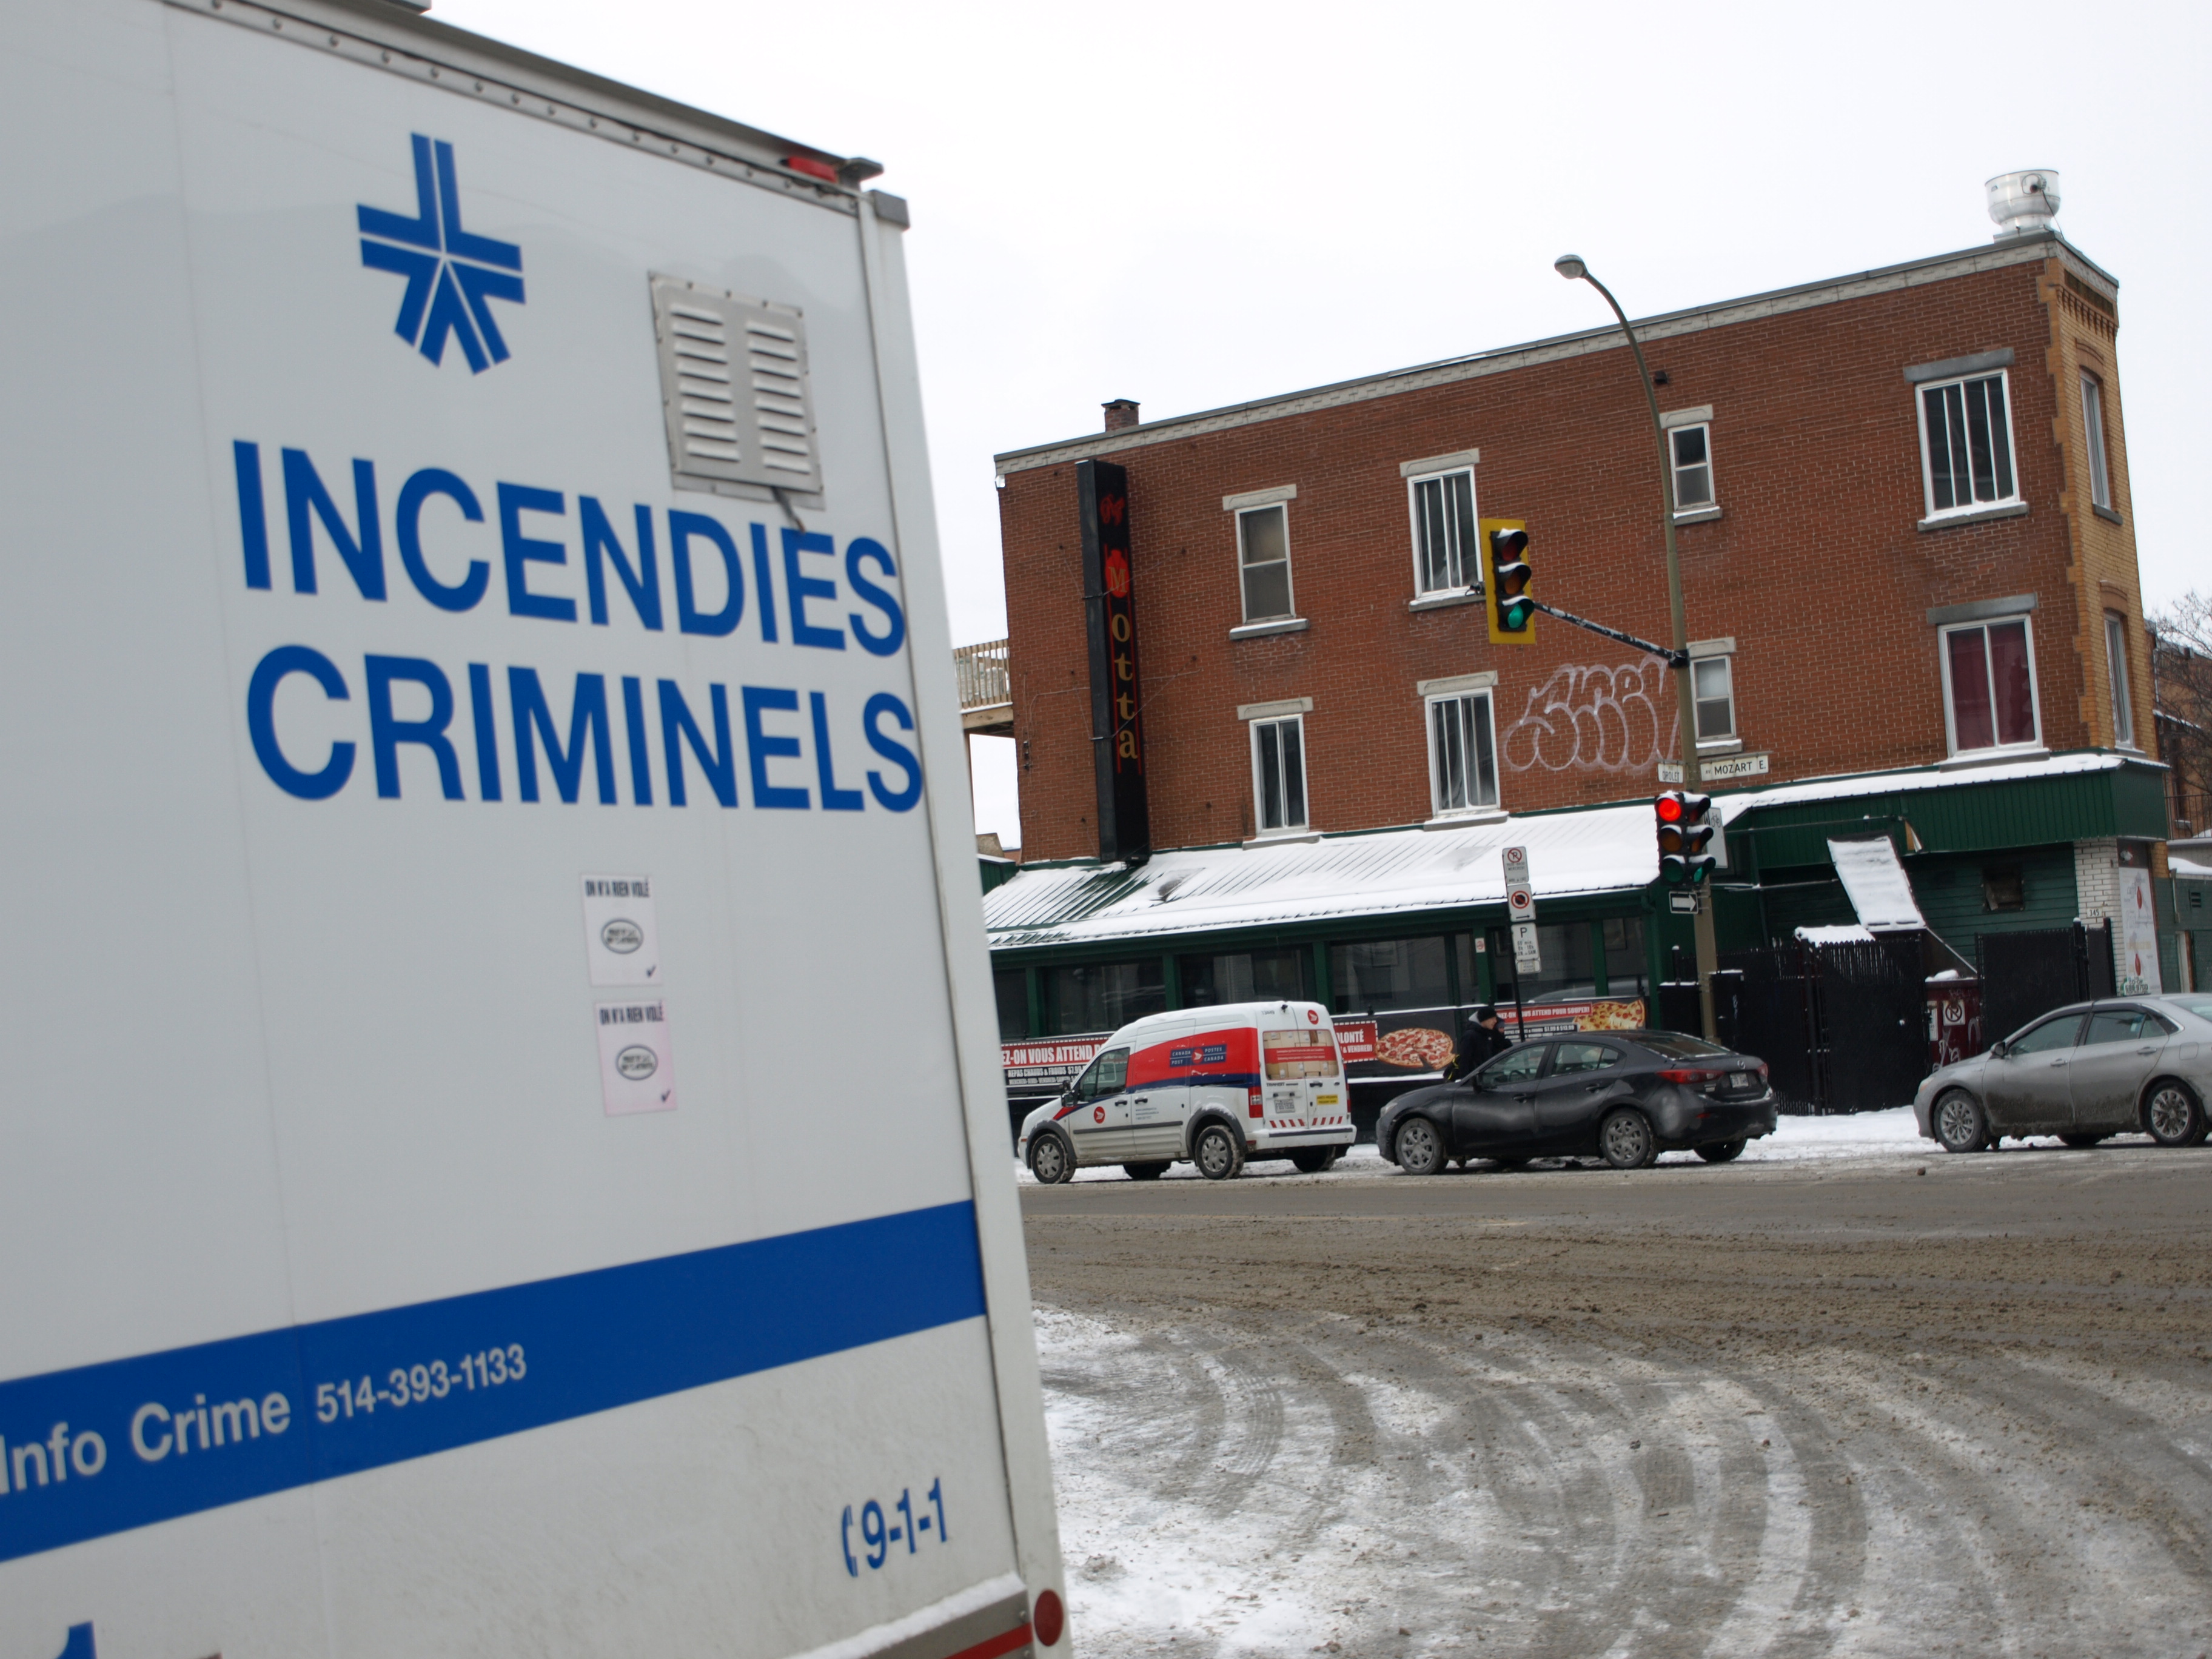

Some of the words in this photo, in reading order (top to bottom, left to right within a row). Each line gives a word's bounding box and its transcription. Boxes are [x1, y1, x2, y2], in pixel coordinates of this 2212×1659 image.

[233, 439, 906, 657] INCENDIES
[1108, 566, 1138, 760] Motta
[247, 644, 922, 813] CRIMINELS
[1714, 761, 1752, 776] MOZART
[1759, 760, 1766, 769] E.
[1520, 927, 1527, 937] P
[1336, 1028, 1364, 1044] LONTÉ
[1028, 1047, 1055, 1064] VOUS
[1056, 1045, 1092, 1062] ATTEND
[1008, 1069, 1023, 1078] REPAS
[0, 1421, 107, 1495] Info
[130, 1391, 292, 1462] Crime
[316, 1342, 528, 1423] 514-393-1133
